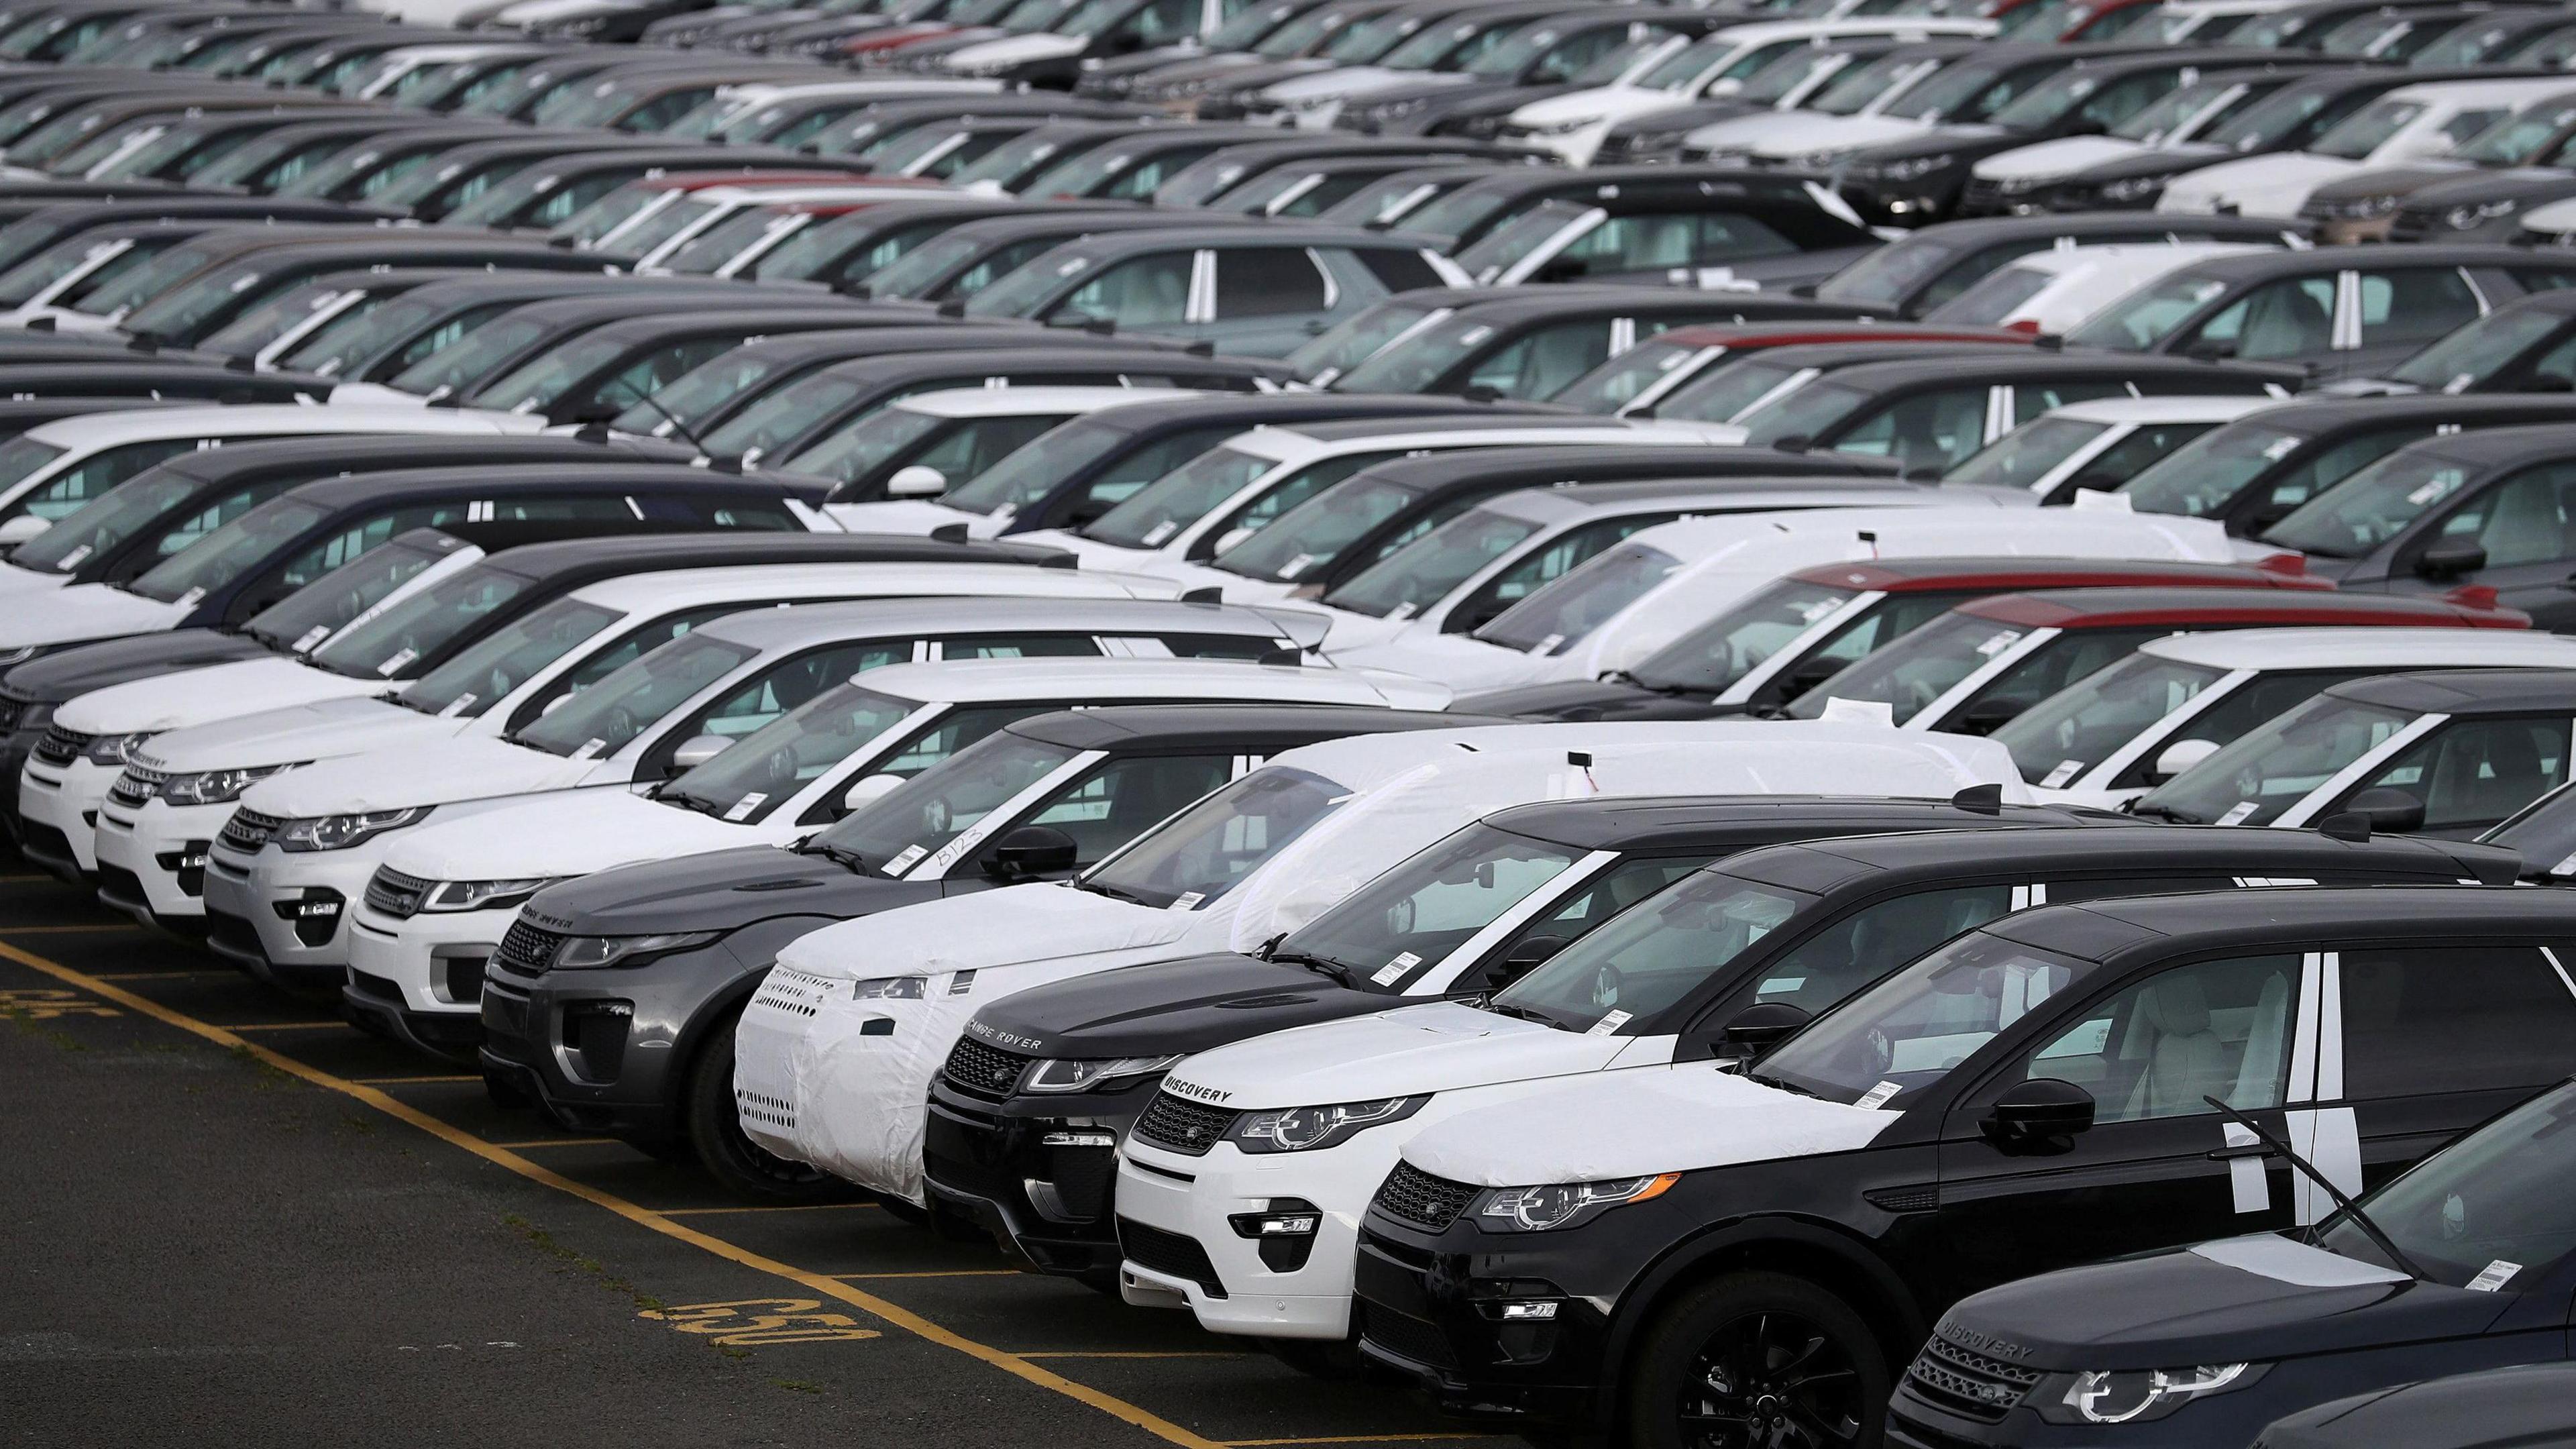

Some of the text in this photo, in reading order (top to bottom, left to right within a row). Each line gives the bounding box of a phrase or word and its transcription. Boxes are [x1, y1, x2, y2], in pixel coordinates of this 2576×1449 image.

[935, 828, 983, 867] B123
[967, 1018, 1042, 1050] ANGE ROVER
[1164, 1075, 1233, 1103] DISCOVERY
[637, 1298, 883, 1345] G50
[1944, 1322, 2035, 1360] DISCOVERY
